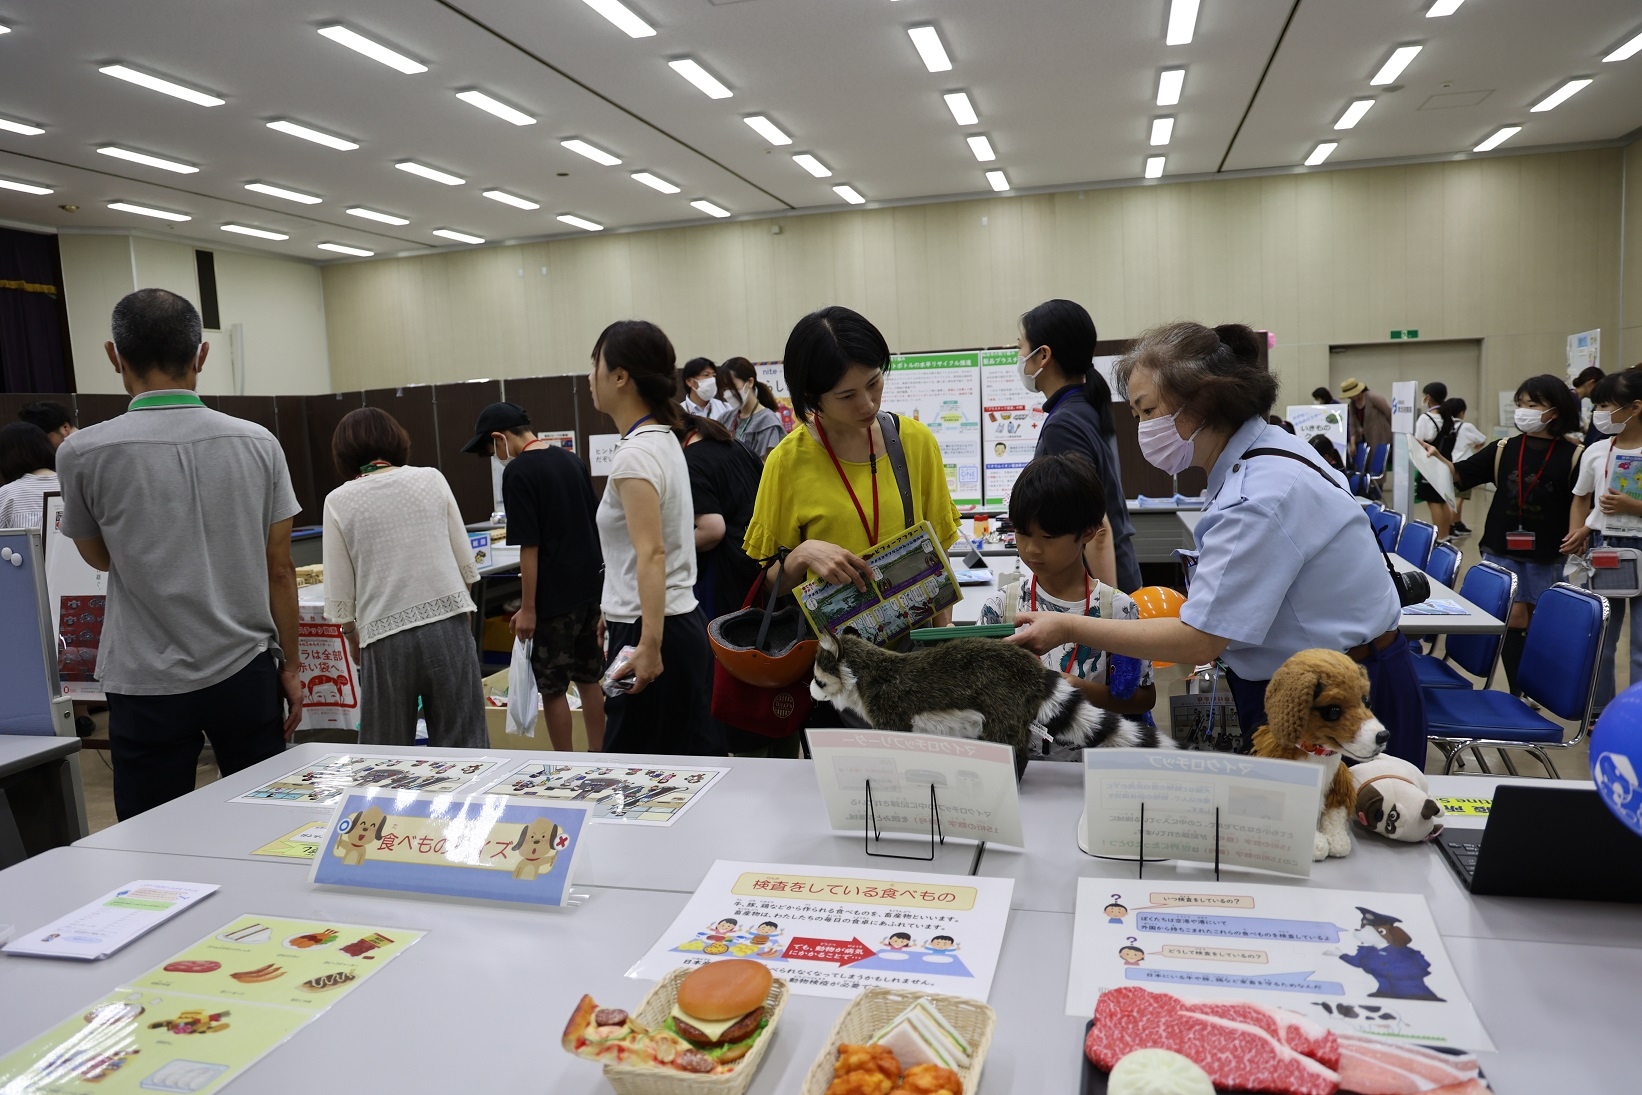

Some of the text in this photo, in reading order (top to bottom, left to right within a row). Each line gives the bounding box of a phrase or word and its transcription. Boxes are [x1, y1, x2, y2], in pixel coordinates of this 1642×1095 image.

[300, 649, 343, 662] ラは全部
[752, 879, 956, 904] 検査をしている食べもの
[793, 943, 864, 955] でも、動物が病気
